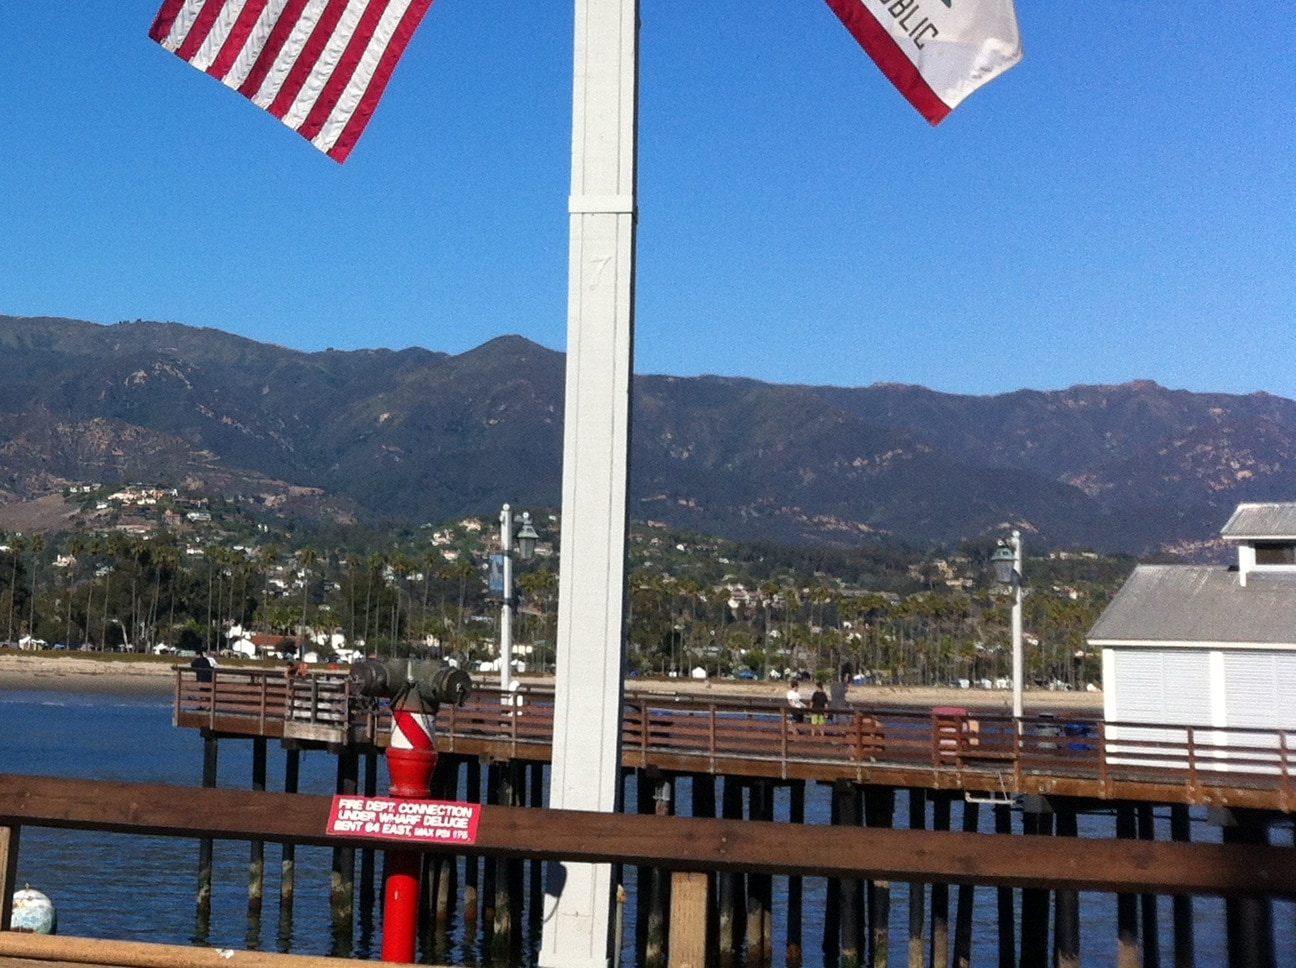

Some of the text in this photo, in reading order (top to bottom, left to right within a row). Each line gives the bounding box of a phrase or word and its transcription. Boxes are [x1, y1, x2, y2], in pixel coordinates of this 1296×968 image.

[338, 798, 363, 811] FIRE
[398, 803, 473, 818] CONNECTION
[337, 810, 468, 829] UNDER WHARF DELUGE
[333, 820, 362, 832] BENT
[413, 828, 434, 838] MAX
[435, 830, 450, 839] PSI
